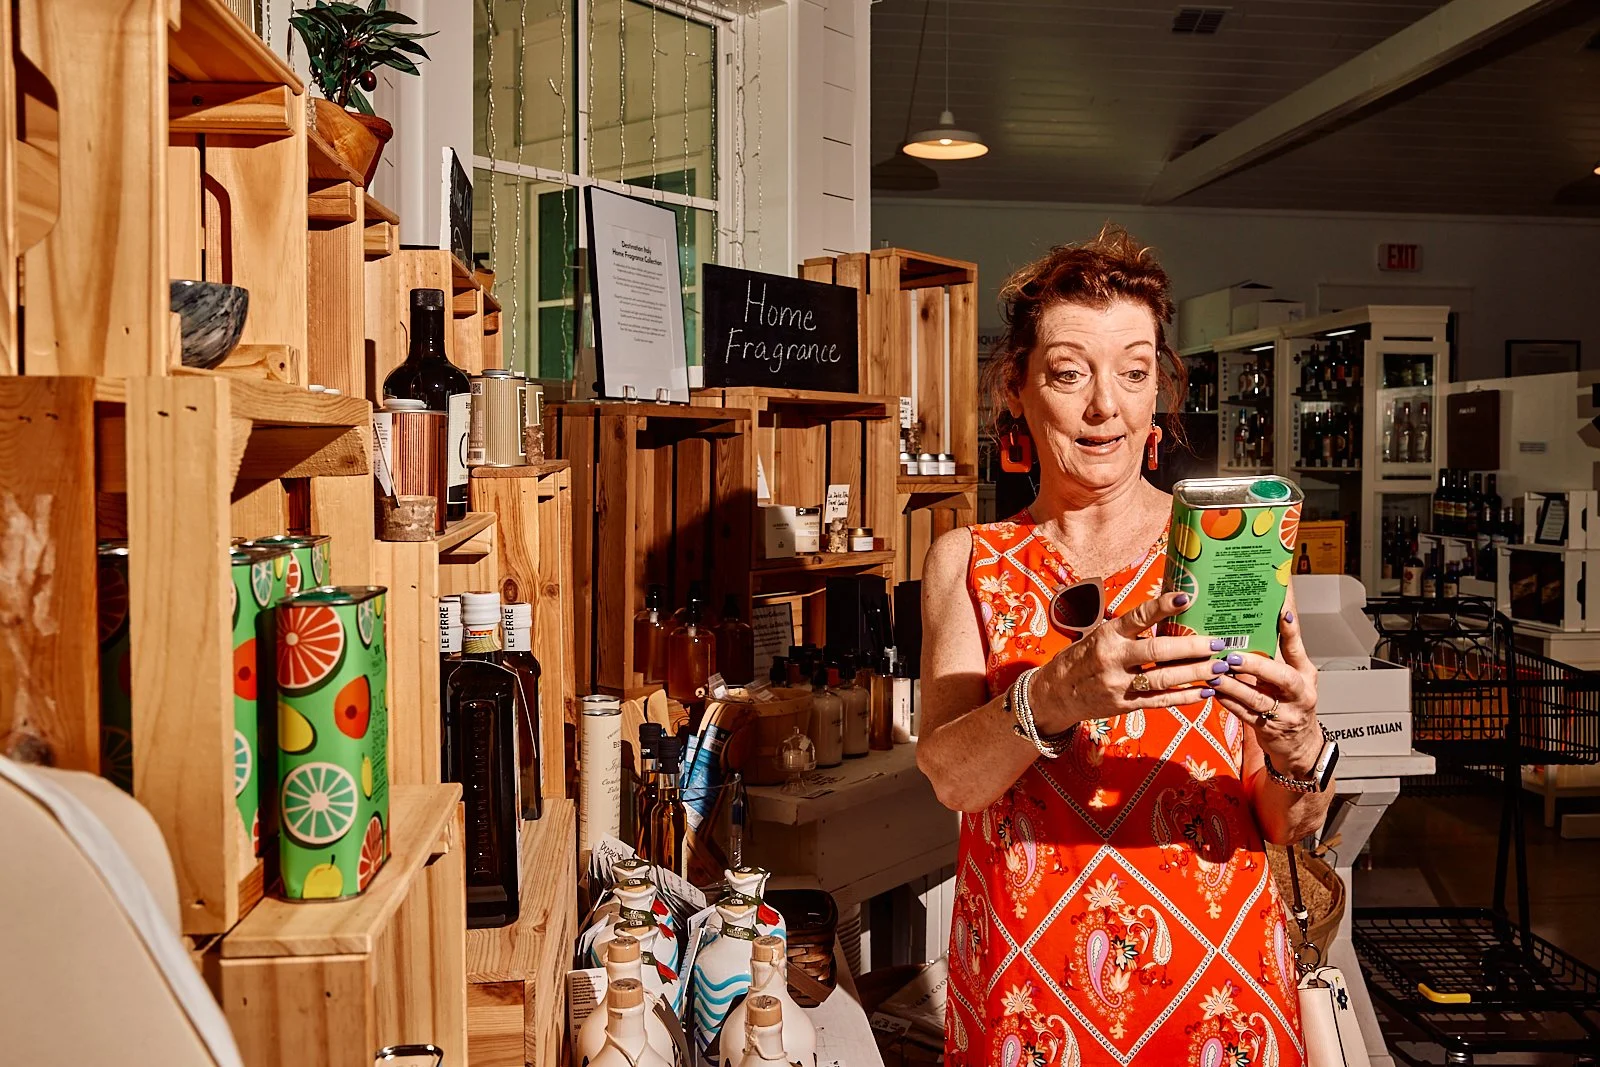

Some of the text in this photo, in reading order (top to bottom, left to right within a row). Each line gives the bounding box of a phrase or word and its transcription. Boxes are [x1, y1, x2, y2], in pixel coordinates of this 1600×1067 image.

[612, 248, 663, 266] Home Fragrance Collection
[621, 240, 644, 252] Destination
[1388, 244, 1417, 269] EXIT
[744, 279, 817, 331] Home
[725, 327, 841, 373] Fragrance
[439, 606, 449, 648] LE FERRE
[504, 608, 514, 648] LE FERRE
[1329, 721, 1403, 741] SPEAKS ITALIAN
